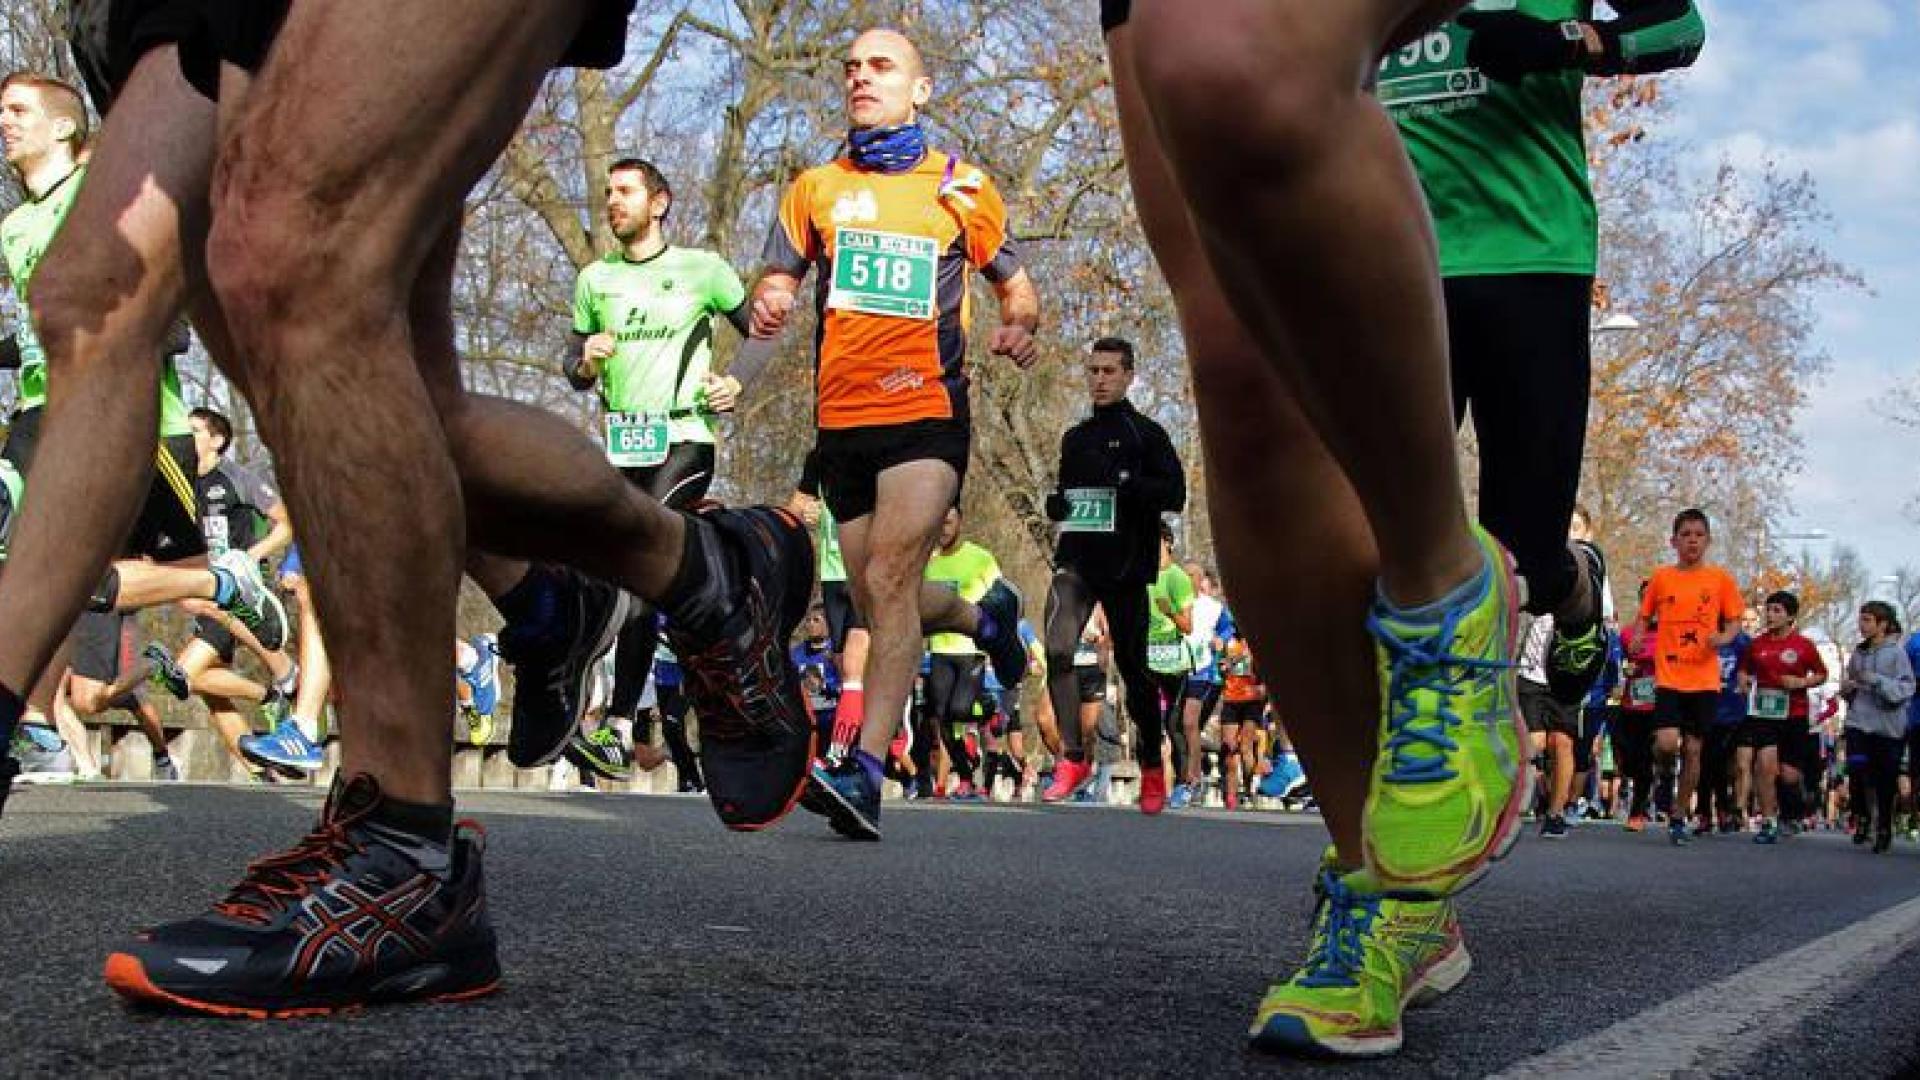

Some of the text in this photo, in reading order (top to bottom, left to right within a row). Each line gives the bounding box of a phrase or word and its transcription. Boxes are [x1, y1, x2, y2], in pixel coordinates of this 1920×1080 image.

[850, 255, 911, 291] 518
[620, 428, 657, 450] 656
[1071, 500, 1100, 517] 771
